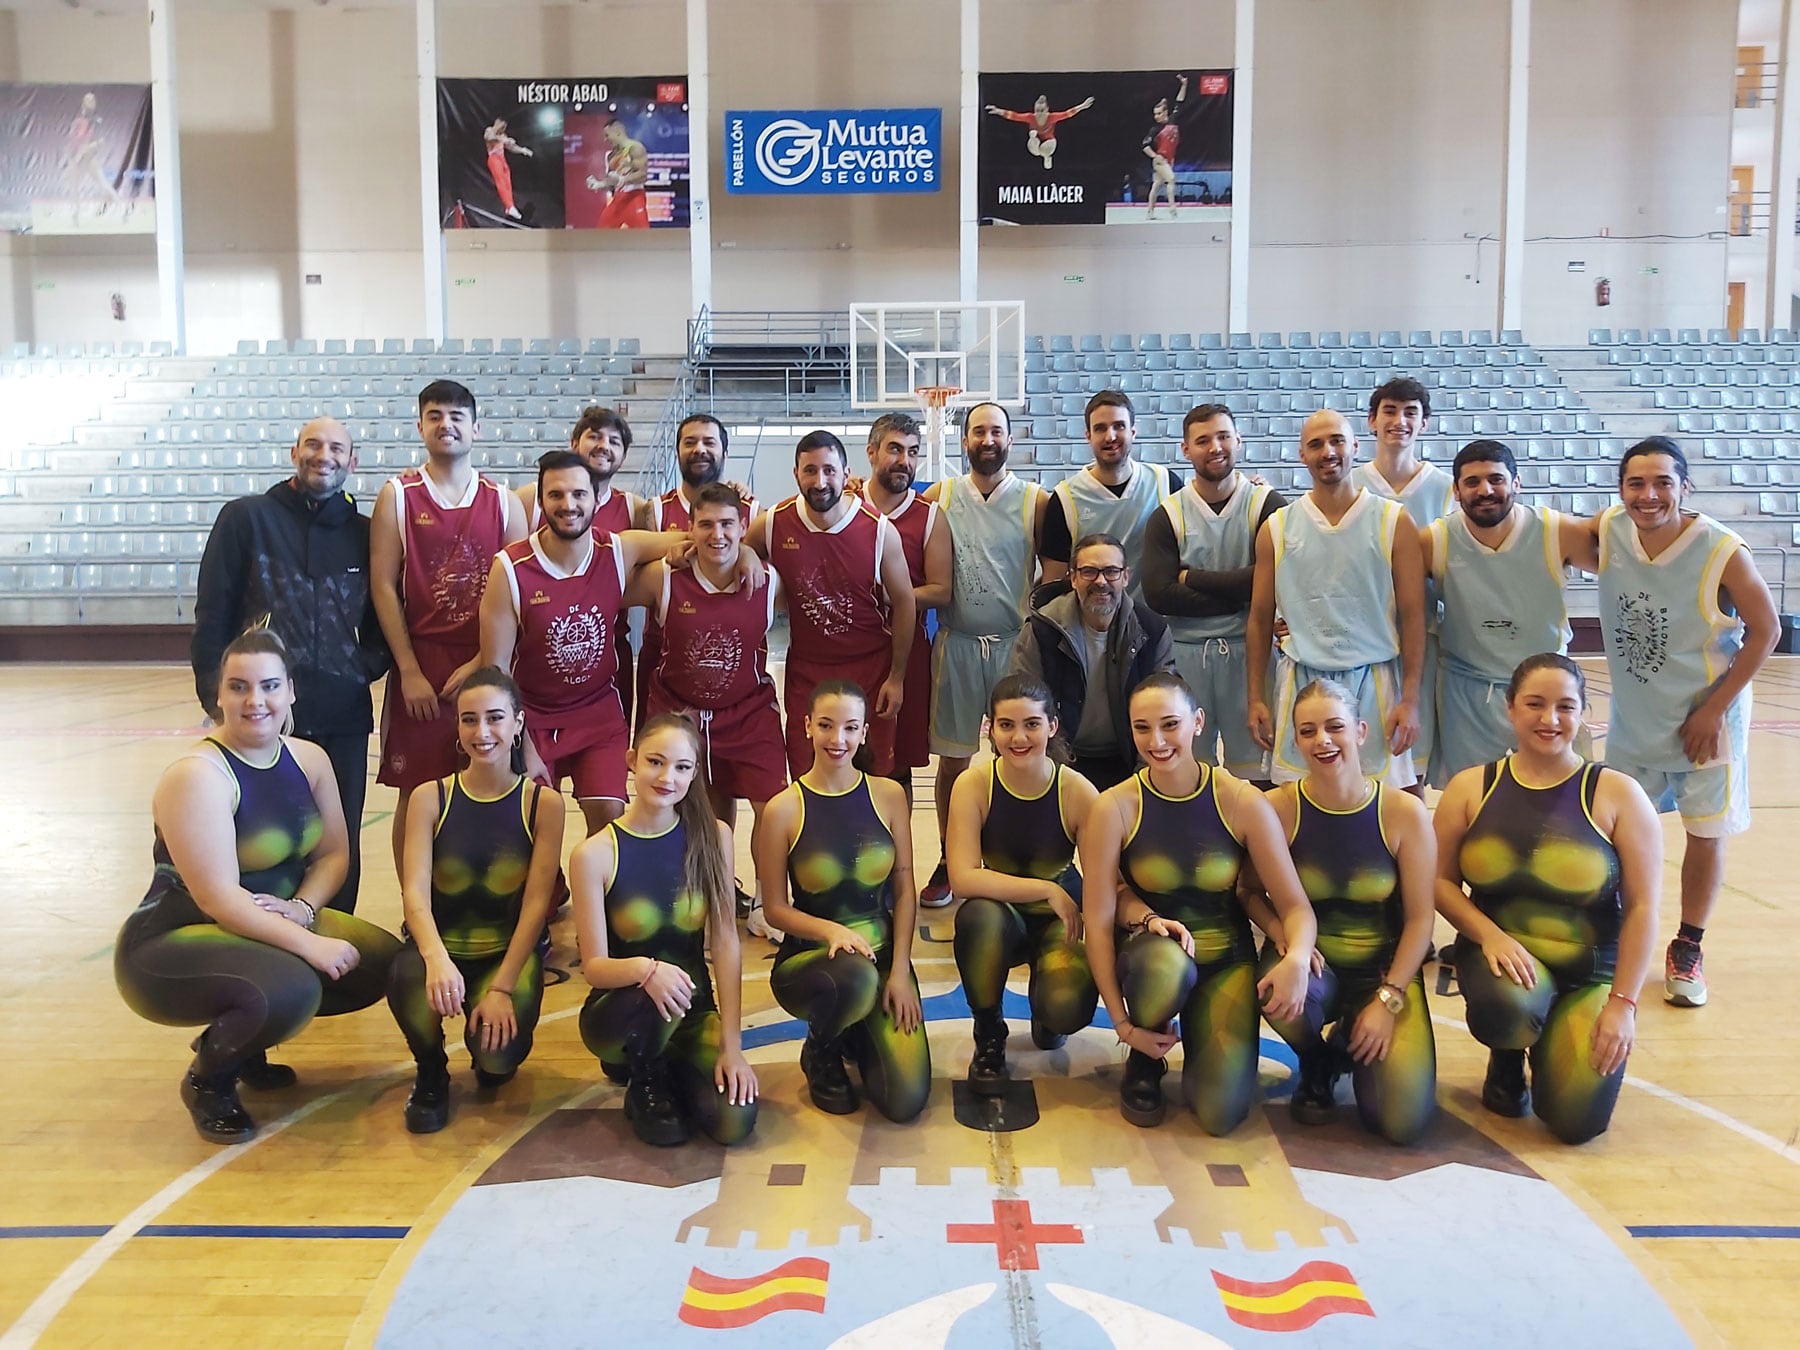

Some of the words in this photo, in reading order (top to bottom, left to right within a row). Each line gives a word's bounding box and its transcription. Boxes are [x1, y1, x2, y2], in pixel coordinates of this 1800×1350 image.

[518, 82, 569, 103] NÉSTOR
[572, 84, 608, 103] ABAD
[826, 119, 928, 147] Mutua
[733, 119, 744, 187] PABELLÓN
[822, 145, 934, 170] Levante
[822, 170, 934, 184] SEGUROS
[998, 186, 1034, 204] MAIA
[1036, 183, 1084, 203] LLÀCER
[1614, 627, 1626, 657] LIGA
[1638, 592, 1652, 602] DE
